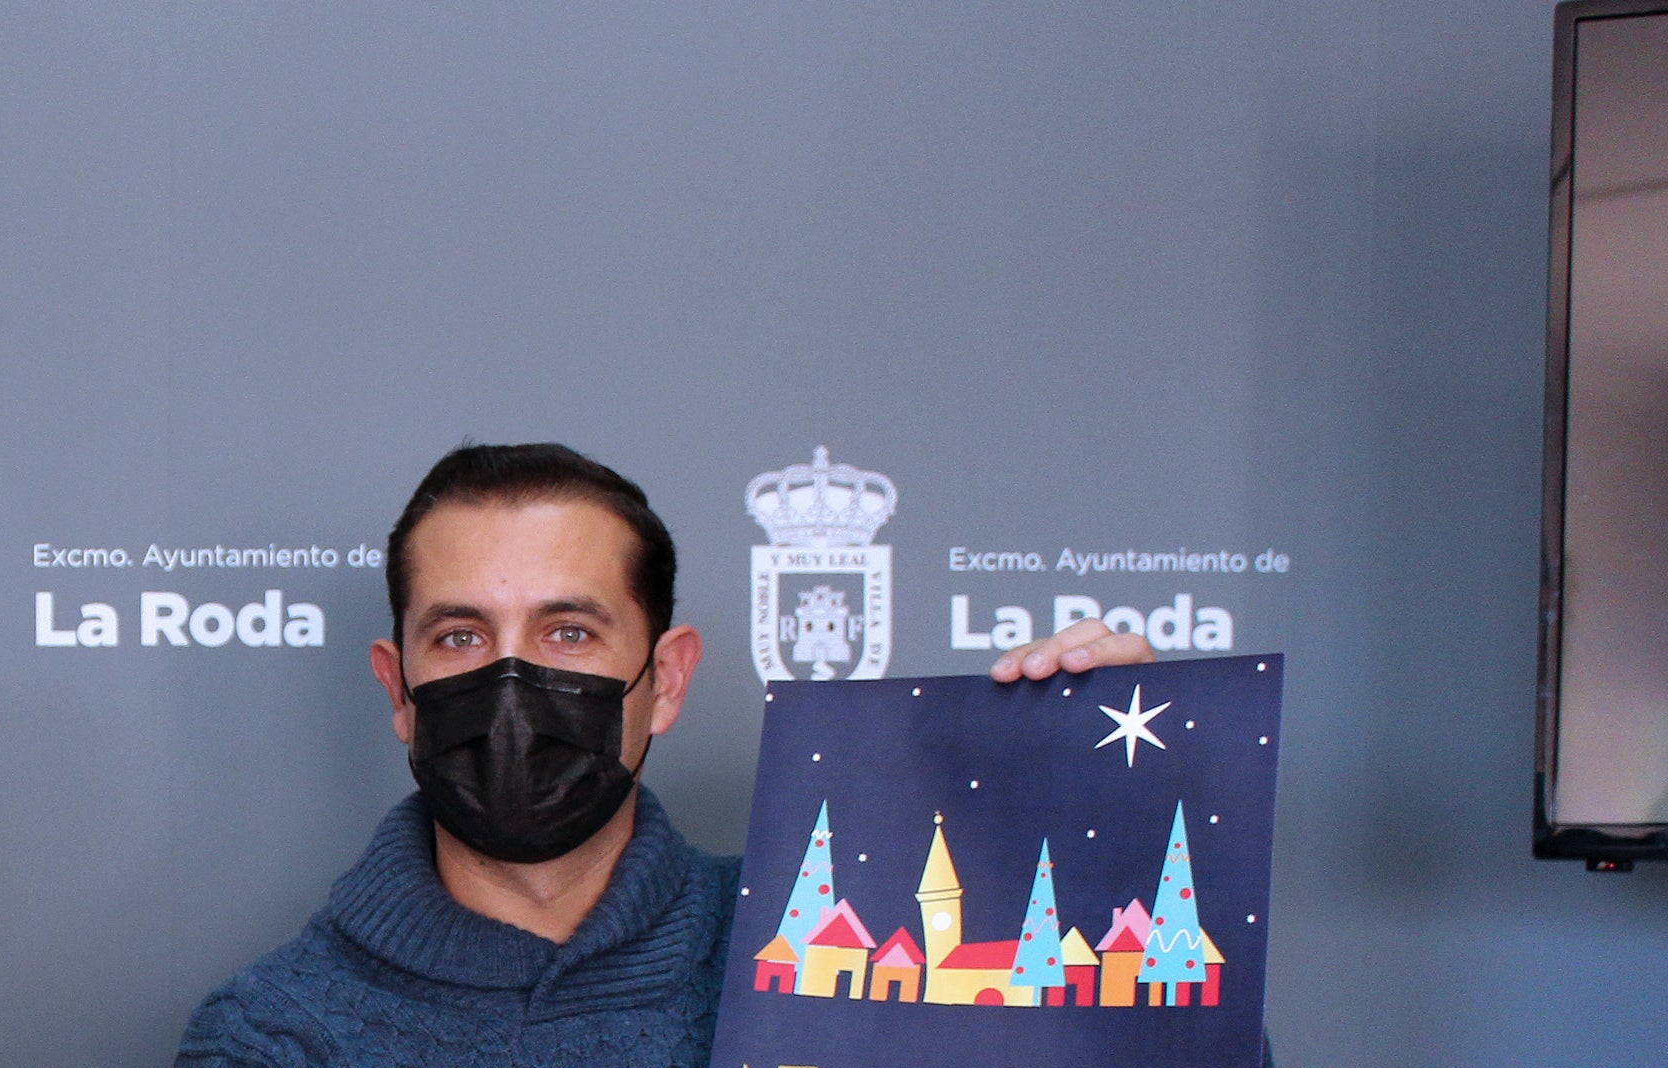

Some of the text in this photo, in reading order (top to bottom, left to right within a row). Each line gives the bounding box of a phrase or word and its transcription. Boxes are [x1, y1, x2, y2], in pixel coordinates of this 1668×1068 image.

[33, 543, 382, 572] Excmo. Ayuntamiento de
[948, 546, 1290, 576] Excmo. Ayuntamiento de
[35, 589, 325, 647] La Roda
[950, 595, 1033, 650] La
